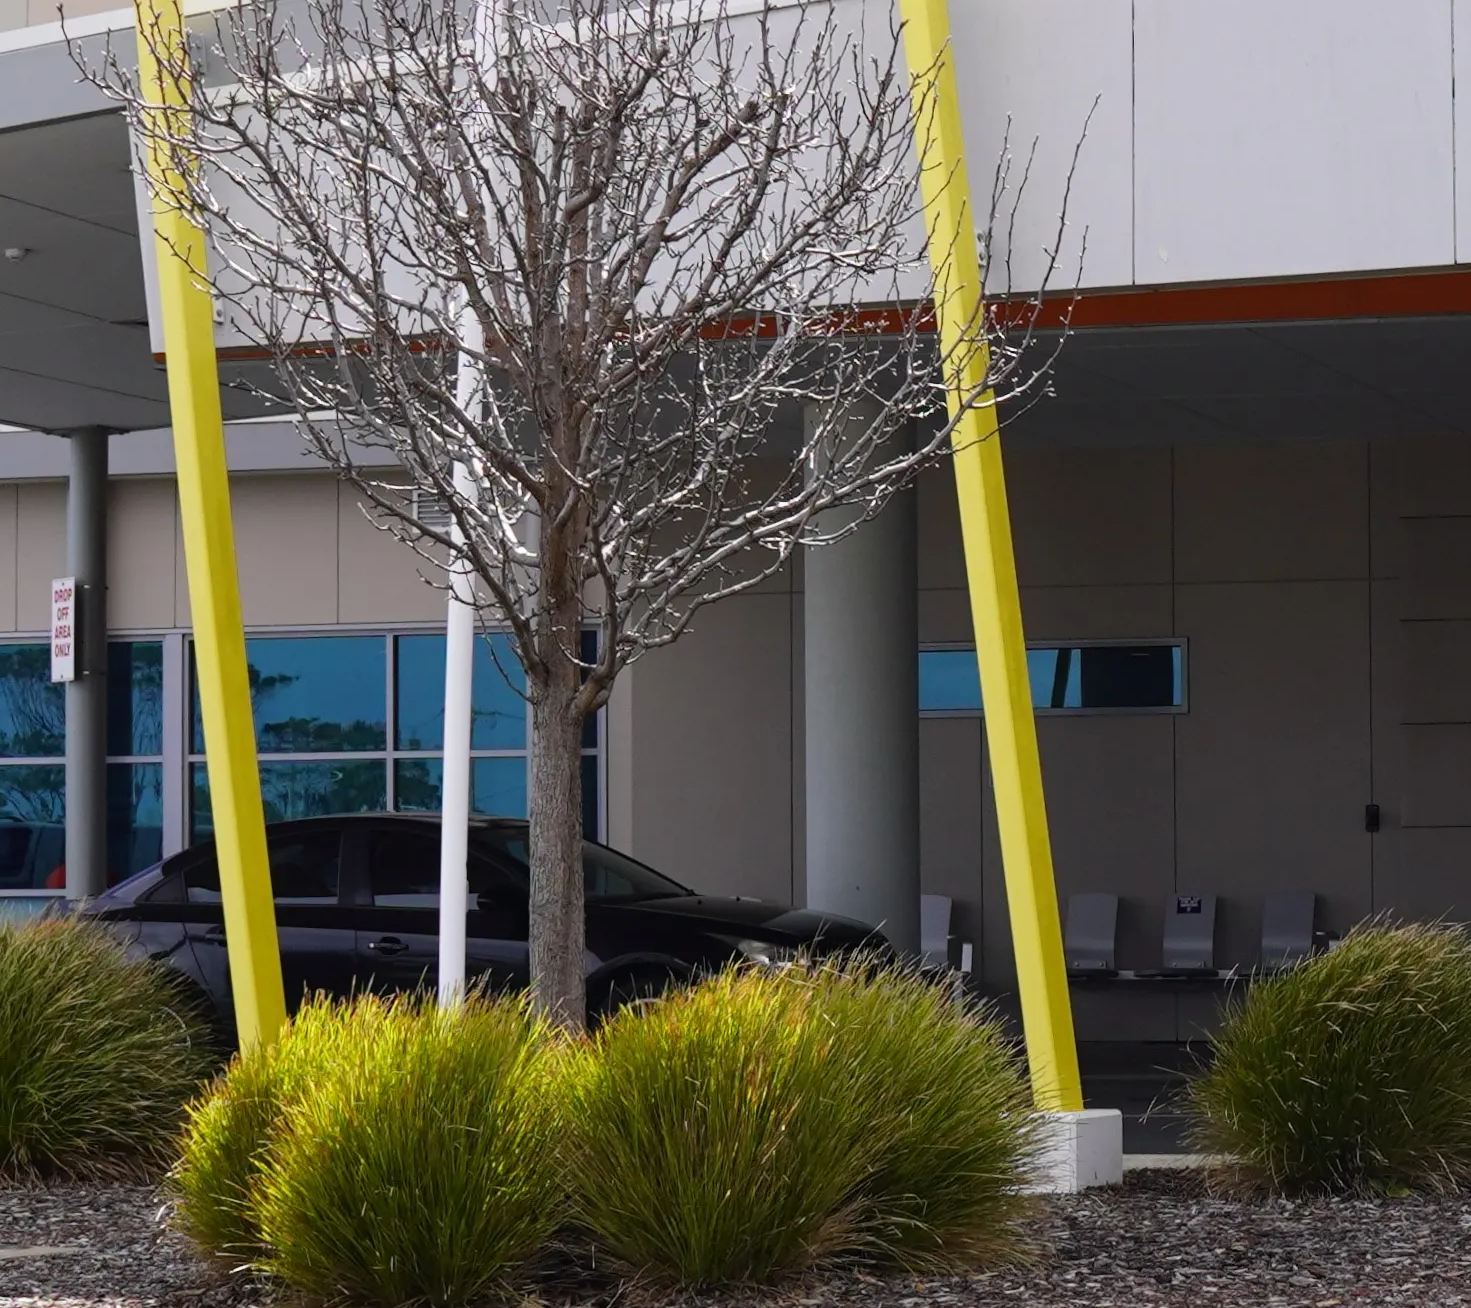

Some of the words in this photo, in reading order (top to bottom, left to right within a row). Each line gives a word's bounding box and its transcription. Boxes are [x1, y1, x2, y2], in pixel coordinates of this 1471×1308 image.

[54, 588, 72, 603] DROP
[56, 606, 69, 621] OFF
[54, 625, 72, 640] AREA
[54, 643, 71, 658] ONLY
